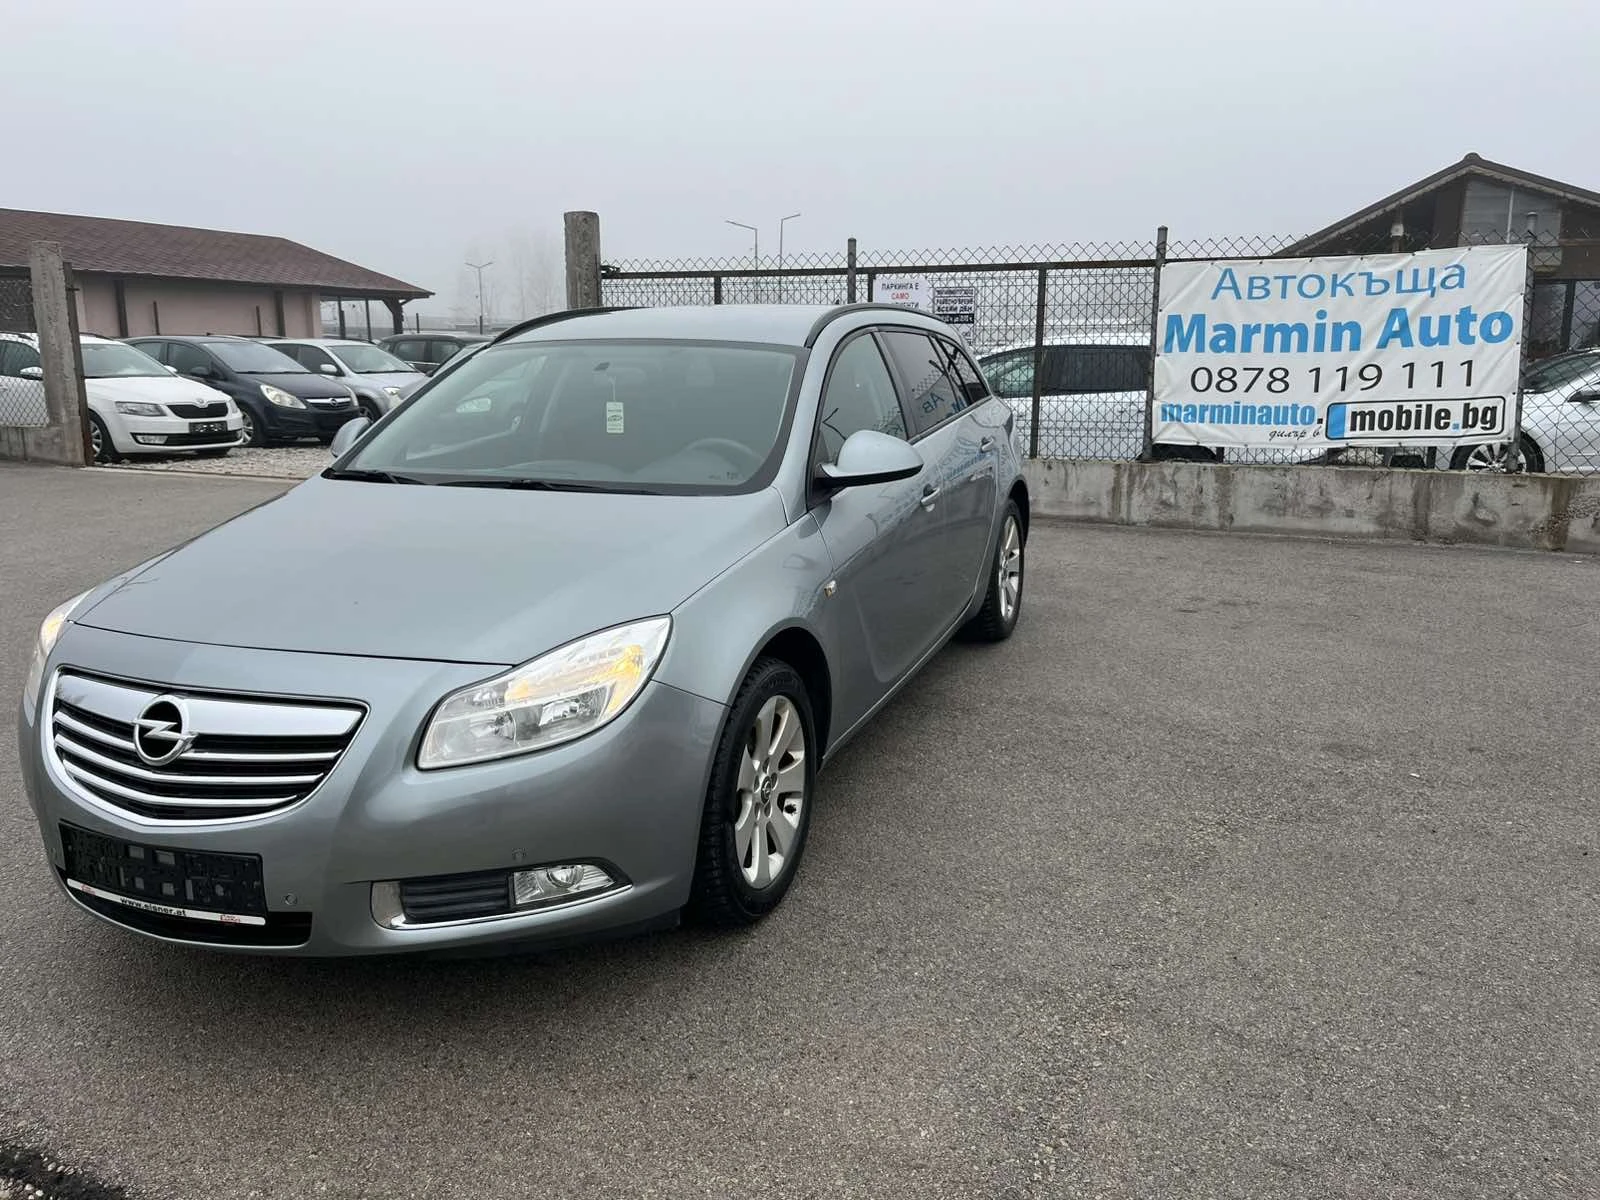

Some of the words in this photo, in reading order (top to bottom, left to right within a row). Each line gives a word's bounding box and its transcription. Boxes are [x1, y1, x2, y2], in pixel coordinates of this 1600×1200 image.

[1211, 264, 1466, 300] Автокъща
[1163, 309, 1363, 354] Marmin
[1376, 304, 1514, 350] Auto
[1190, 366, 1291, 394] 0878
[1308, 363, 1383, 393] 119
[1402, 359, 1474, 389] 111
[1349, 402, 1498, 432] mobile.bg
